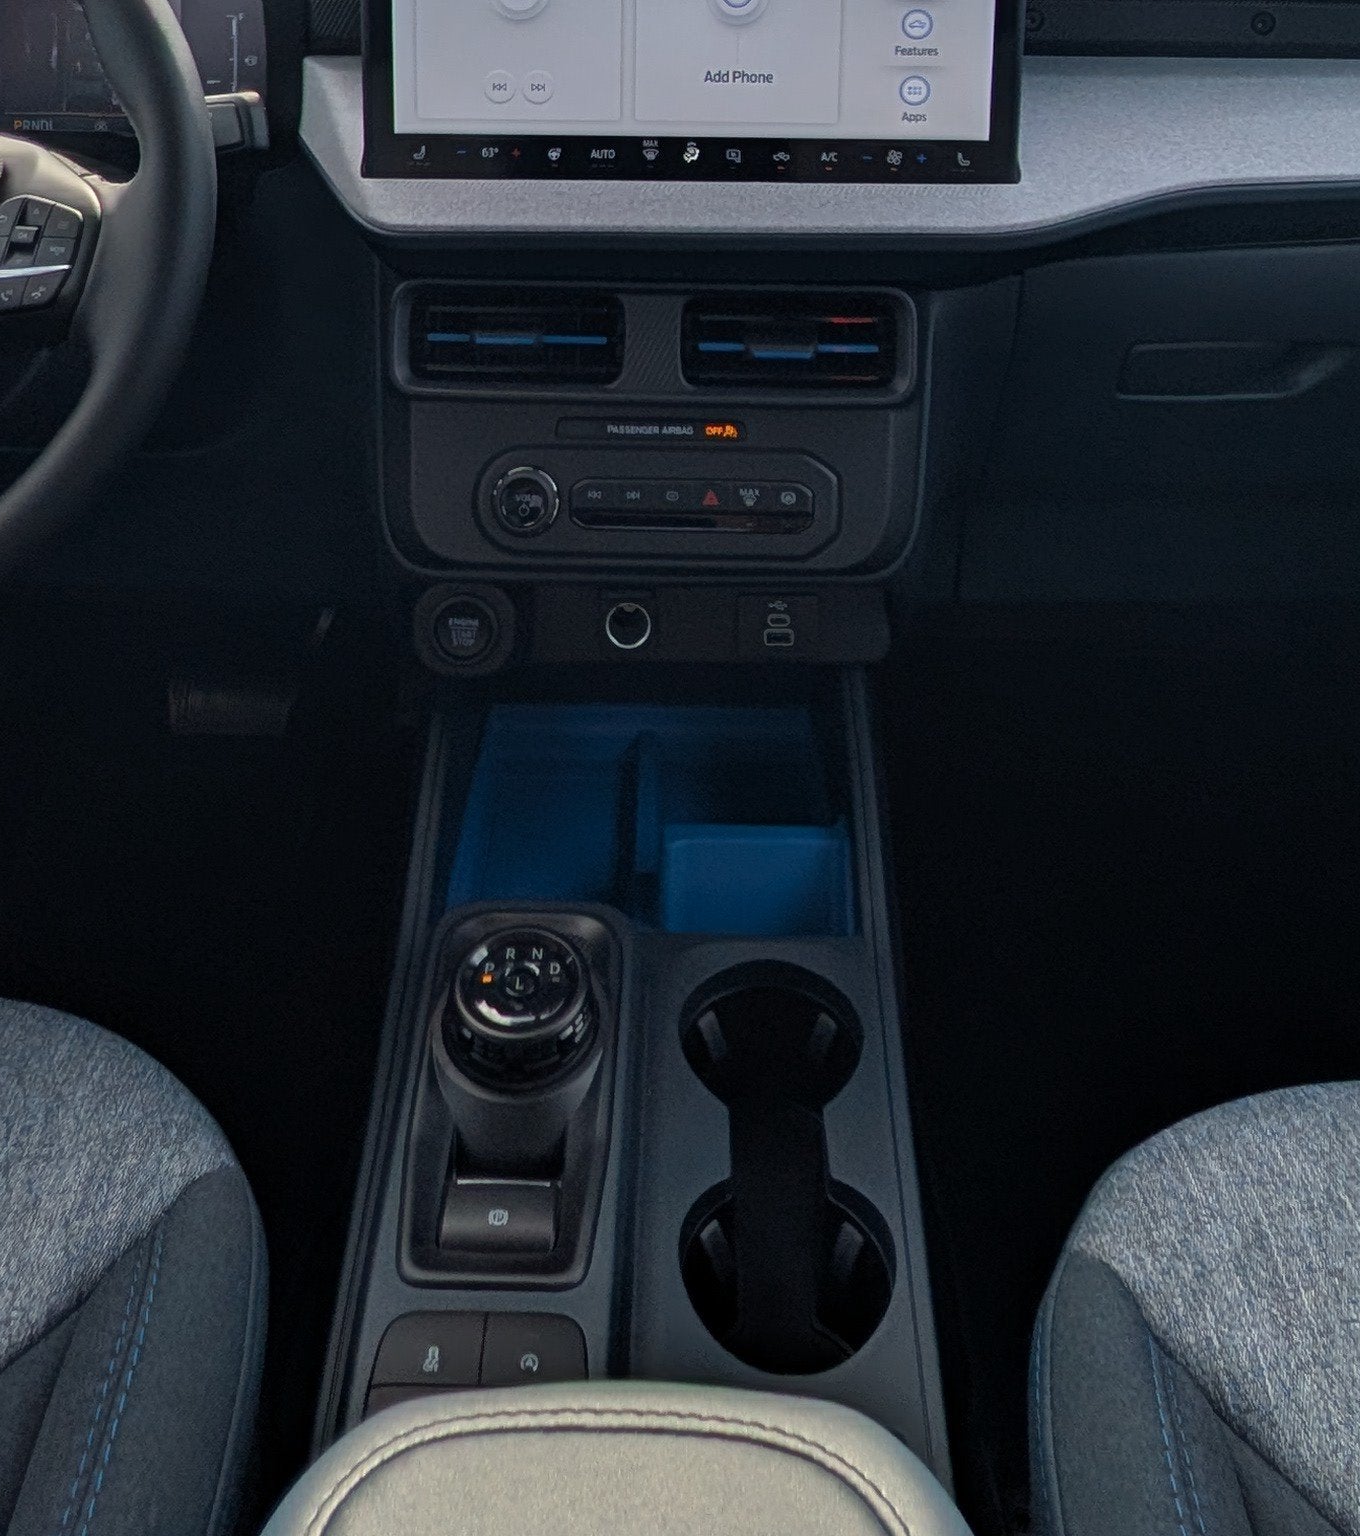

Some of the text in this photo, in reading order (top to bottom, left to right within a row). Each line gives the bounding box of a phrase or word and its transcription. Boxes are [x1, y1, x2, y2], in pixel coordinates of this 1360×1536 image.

[894, 45, 940, 56] Features
[704, 70, 774, 83] Add Phone
[901, 112, 927, 123] Apps
[590, 149, 616, 159] AUTO
[821, 152, 838, 162] A/C
[606, 425, 694, 435] PASSENGER AIRBAG
[705, 425, 723, 435] OFF
[505, 947, 516, 960] R
[532, 947, 543, 960] N
[484, 962, 495, 975] P
[549, 962, 561, 975] D
[515, 976, 524, 990] L
